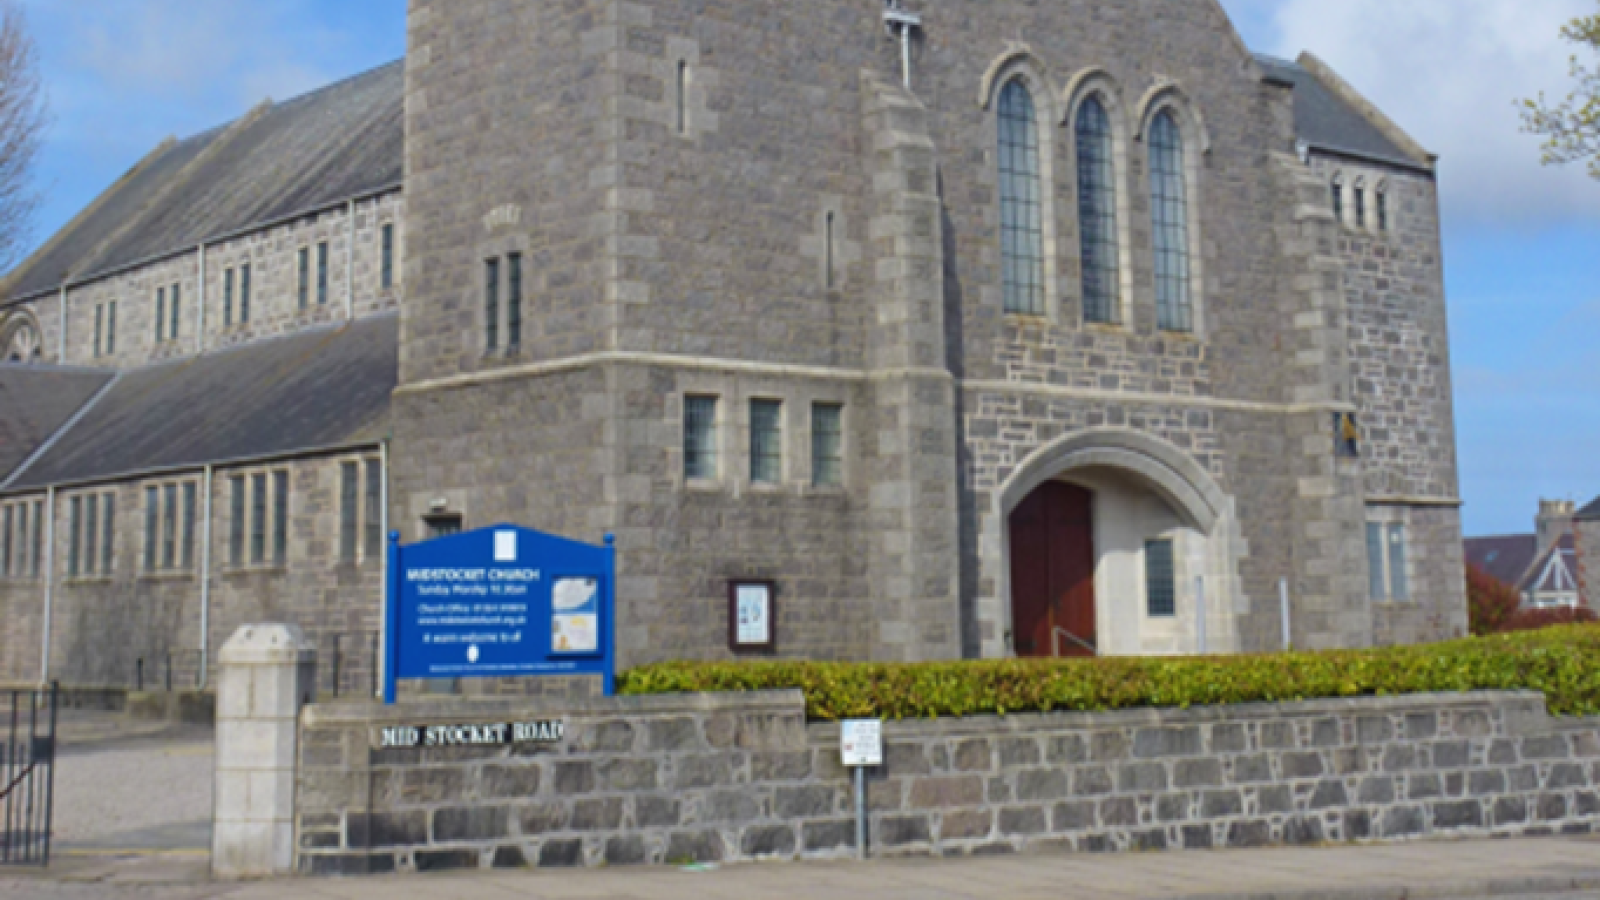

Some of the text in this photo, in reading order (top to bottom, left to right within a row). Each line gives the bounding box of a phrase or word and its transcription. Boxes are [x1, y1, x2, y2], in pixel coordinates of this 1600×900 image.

[406, 568, 540, 581] MIDSTOCKET CHURCH
[417, 584, 450, 597] Sunday
[452, 584, 488, 597] Worship
[381, 718, 563, 746] MID STOCKET ROAD
